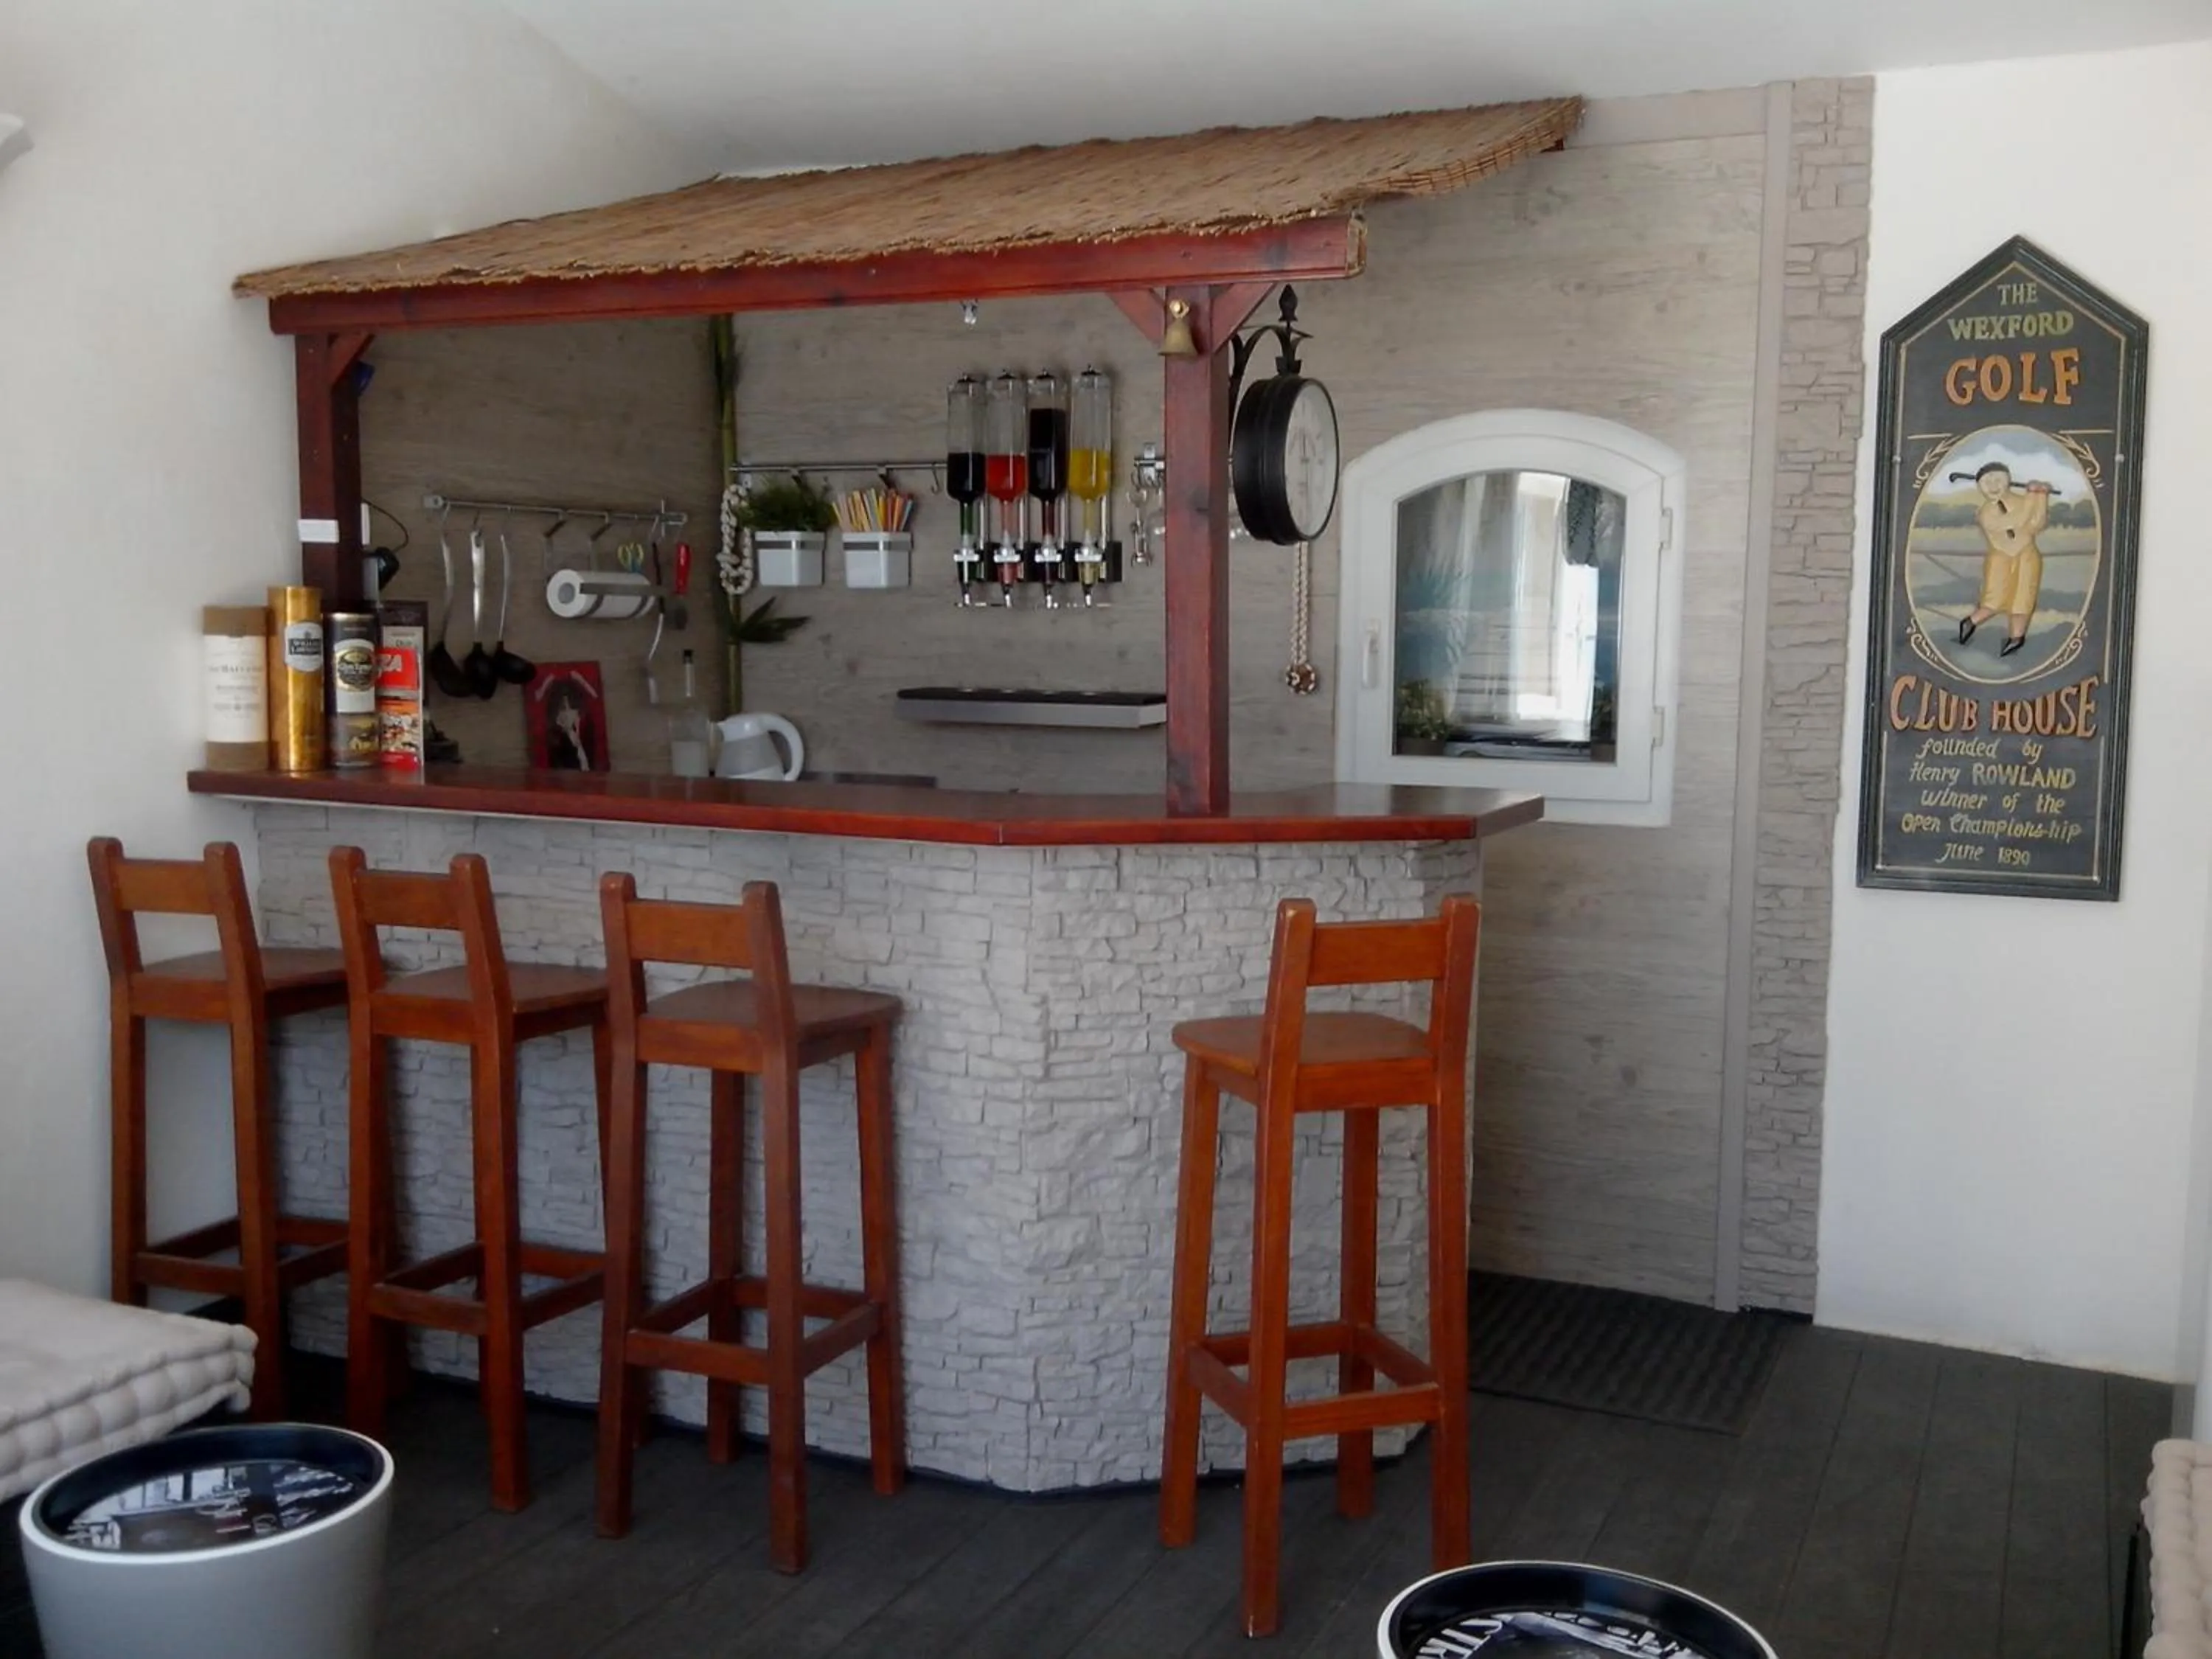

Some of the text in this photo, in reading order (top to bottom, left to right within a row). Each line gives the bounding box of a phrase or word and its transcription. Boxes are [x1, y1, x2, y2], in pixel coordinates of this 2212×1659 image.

[1997, 282, 2037, 306] THE
[1947, 310, 2074, 341] WEXFORD
[1944, 347, 2081, 406] GOLF
[1889, 674, 2100, 738] CLUB HOUSE
[1916, 737, 2043, 764] founded by
[1909, 760, 2076, 789] Henry ROWLAND
[1921, 787, 2065, 815] winner of the
[1935, 841, 2031, 866] June 1890
